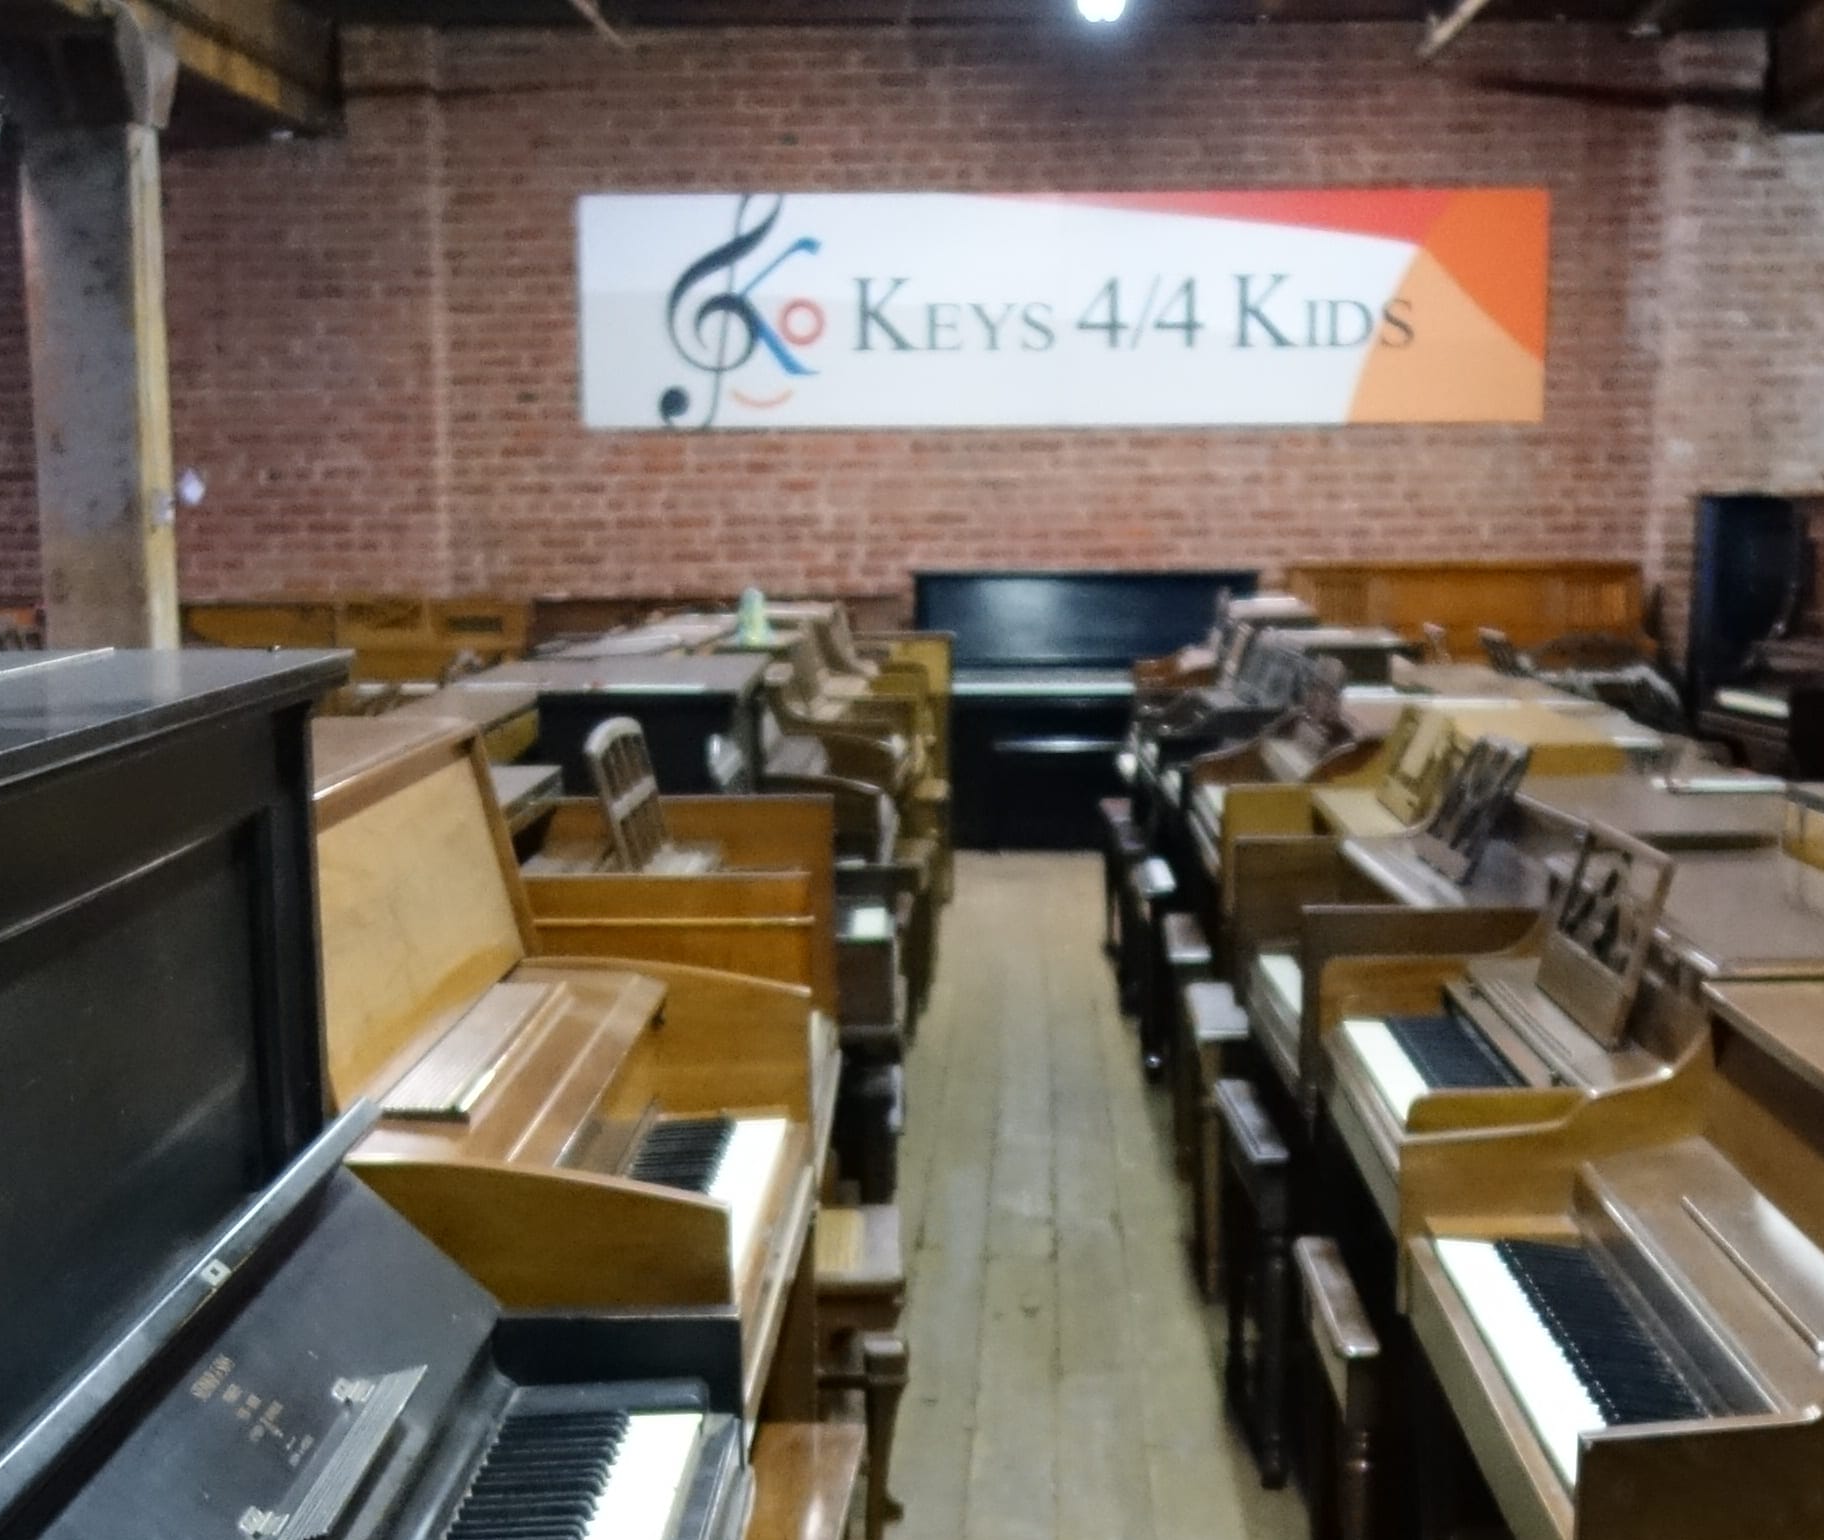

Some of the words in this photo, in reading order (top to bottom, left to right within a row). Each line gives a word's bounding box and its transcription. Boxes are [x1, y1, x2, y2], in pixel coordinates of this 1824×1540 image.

[851, 276, 1056, 351] KEYS
[1076, 274, 1204, 350] 4/4
[1234, 273, 1415, 348] KIDS
